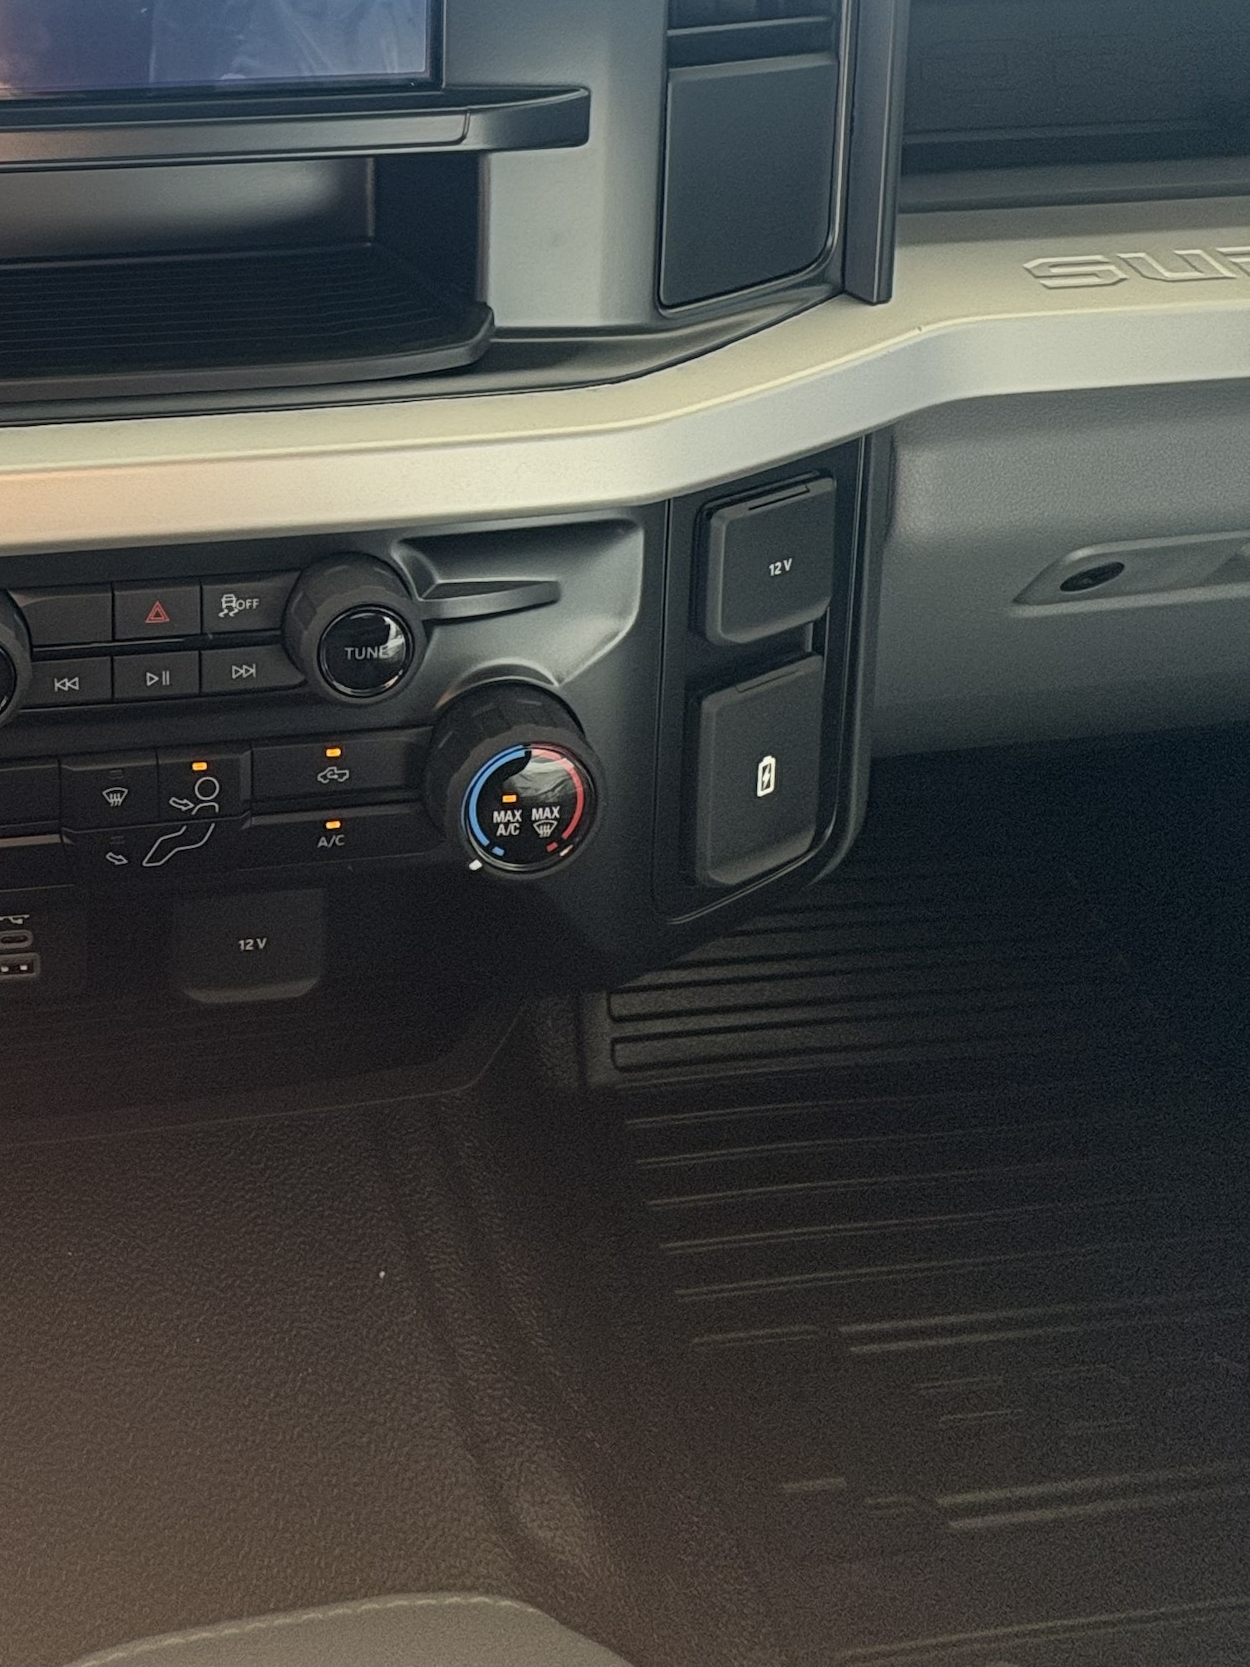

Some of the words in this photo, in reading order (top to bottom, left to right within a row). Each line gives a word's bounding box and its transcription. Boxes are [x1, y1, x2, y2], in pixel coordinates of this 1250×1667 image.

[769, 561, 782, 577] 12
[783, 557, 793, 572] V
[236, 598, 260, 611] OFF
[344, 645, 391, 661] TUNE
[493, 809, 523, 824] MAX
[531, 806, 561, 821] MAX
[496, 822, 520, 837] A/C
[317, 834, 346, 848] A/C
[238, 938, 254, 952] 12
[256, 937, 268, 950] V
